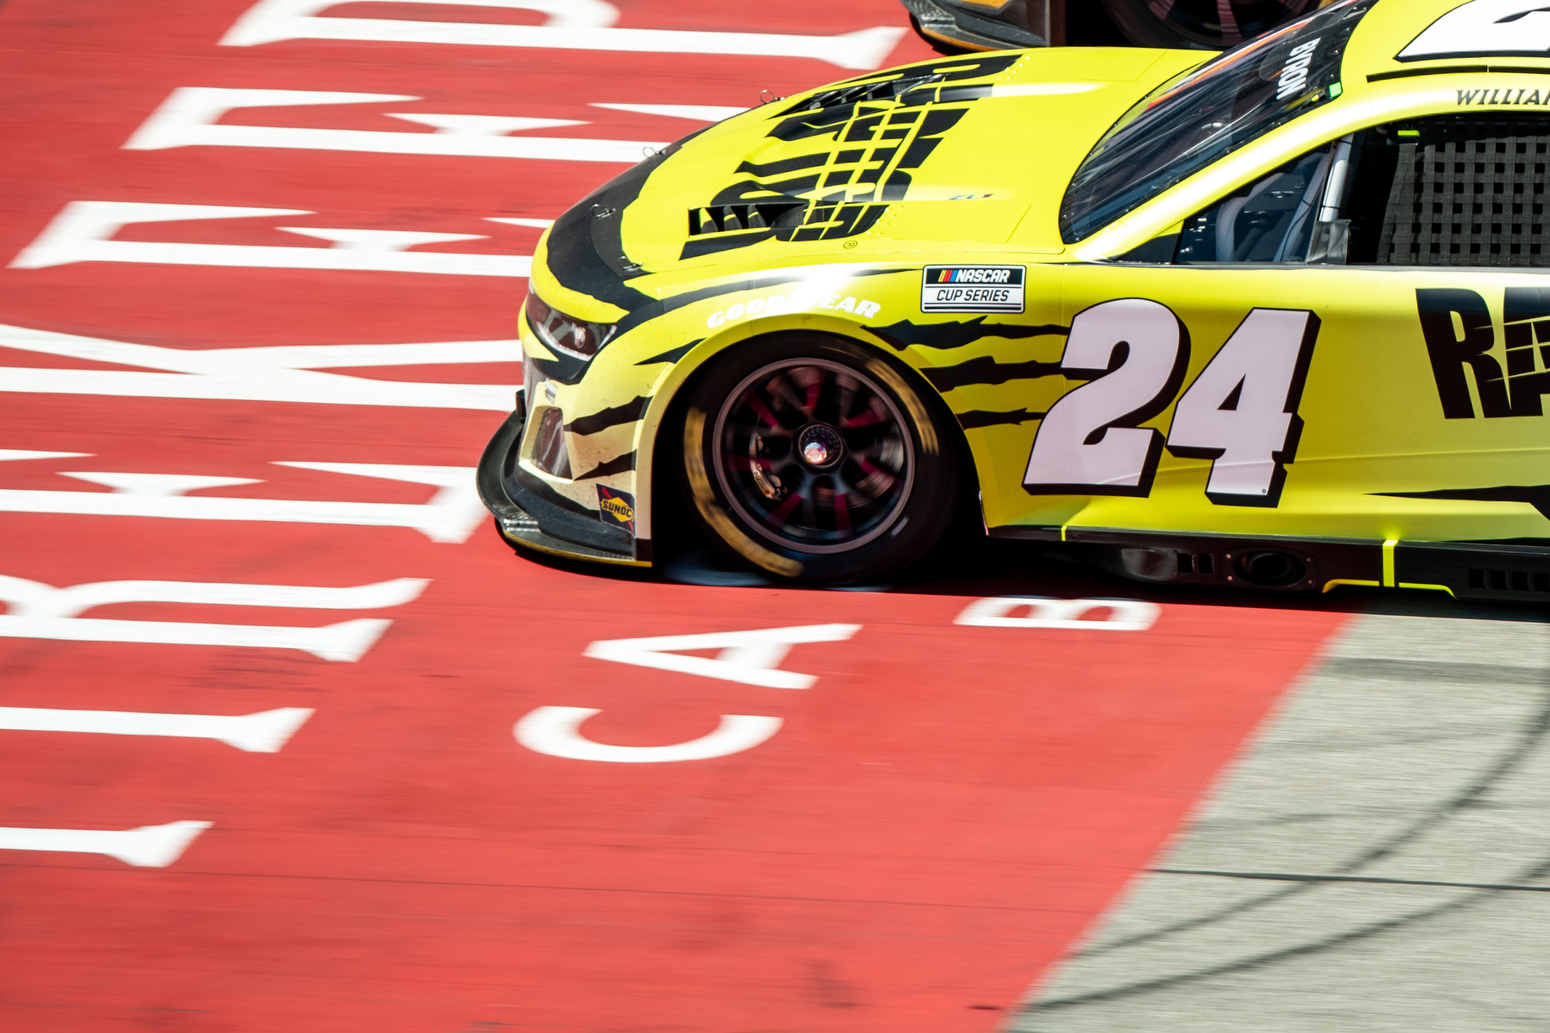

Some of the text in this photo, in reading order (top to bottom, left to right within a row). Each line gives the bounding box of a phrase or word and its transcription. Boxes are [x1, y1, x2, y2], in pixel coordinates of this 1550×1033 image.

[1276, 37, 1321, 100] BYRON
[956, 269, 1011, 283] NASCAR
[706, 292, 881, 328] GOODEAR
[936, 289, 1010, 302] CUP SERIES
[1021, 297, 1321, 508] 24
